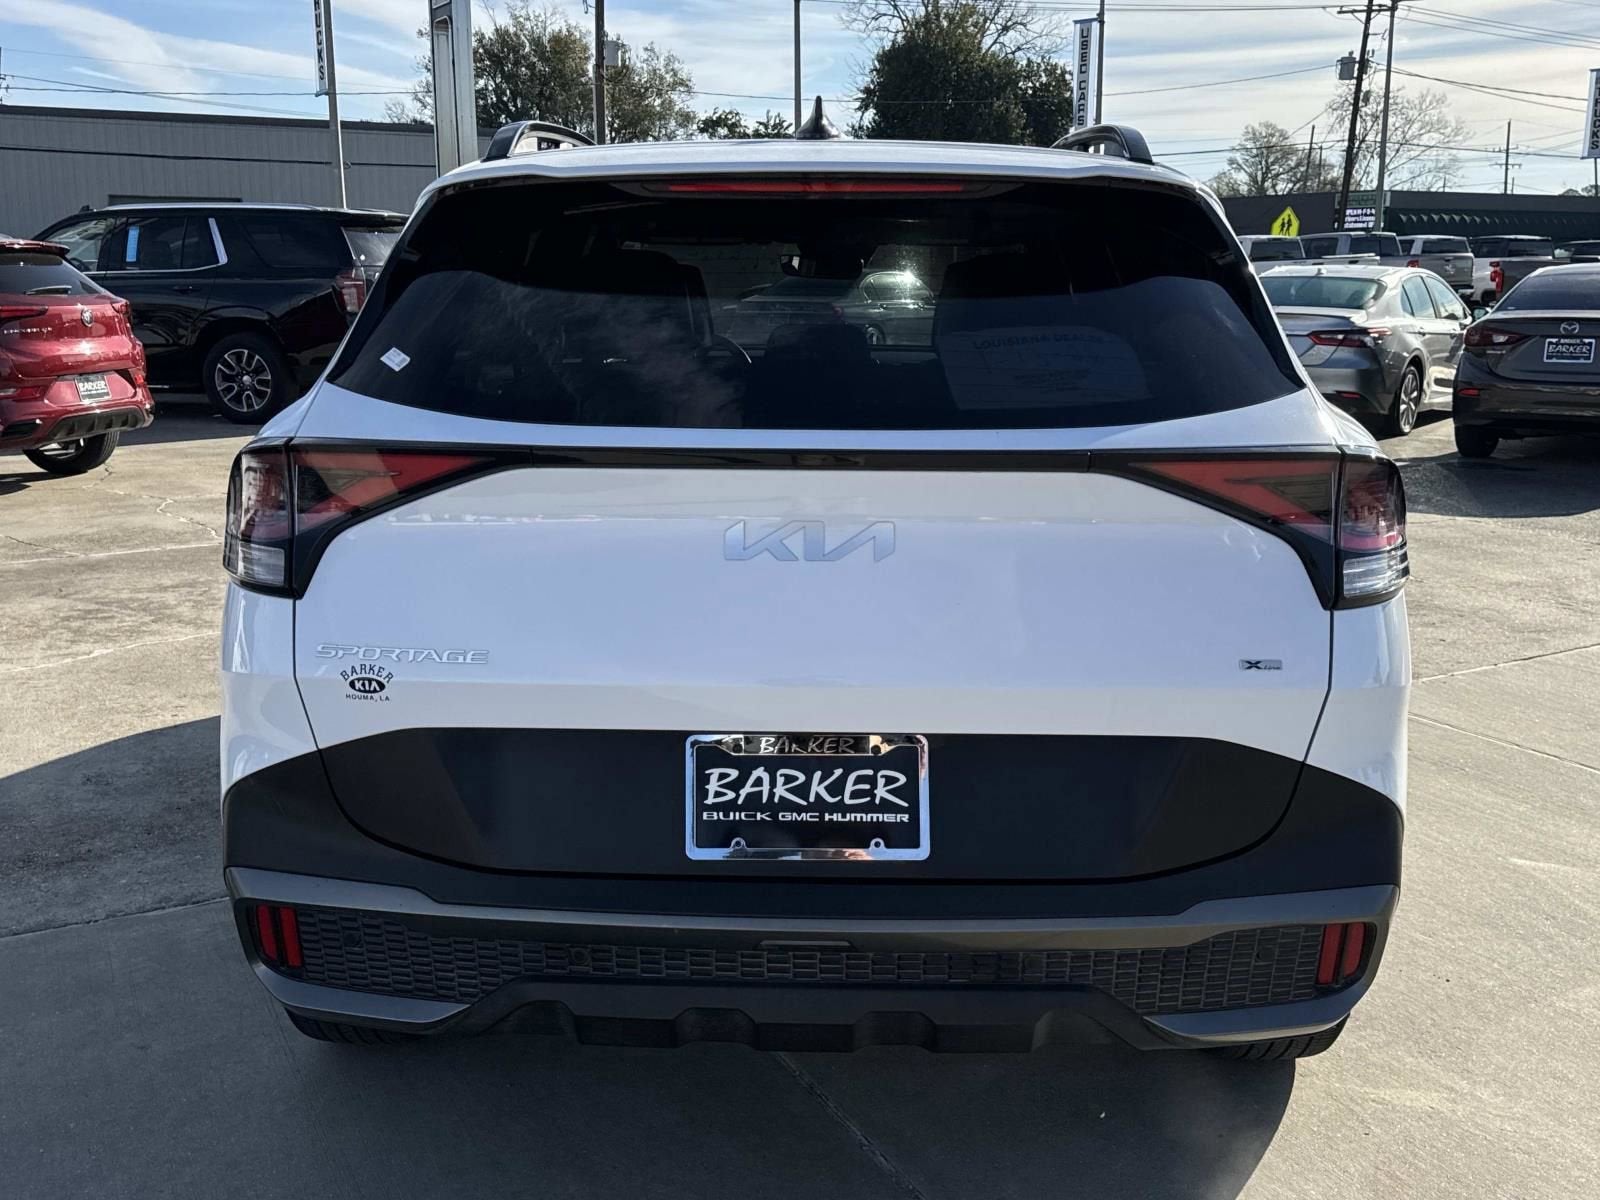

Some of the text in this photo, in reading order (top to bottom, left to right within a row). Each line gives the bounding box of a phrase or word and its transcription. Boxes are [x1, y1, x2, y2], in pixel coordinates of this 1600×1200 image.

[1077, 28, 1089, 126] USED CARS
[1548, 344, 1591, 353] BARKER
[315, 643, 489, 664] SPORTAGE
[339, 664, 394, 684] BARKER
[353, 679, 381, 692] KIA
[345, 693, 390, 702] HOUMA, LA
[759, 736, 856, 754] BARKER
[703, 766, 909, 807] BARKER
[702, 811, 909, 823] BUICK GMC HUMMER
